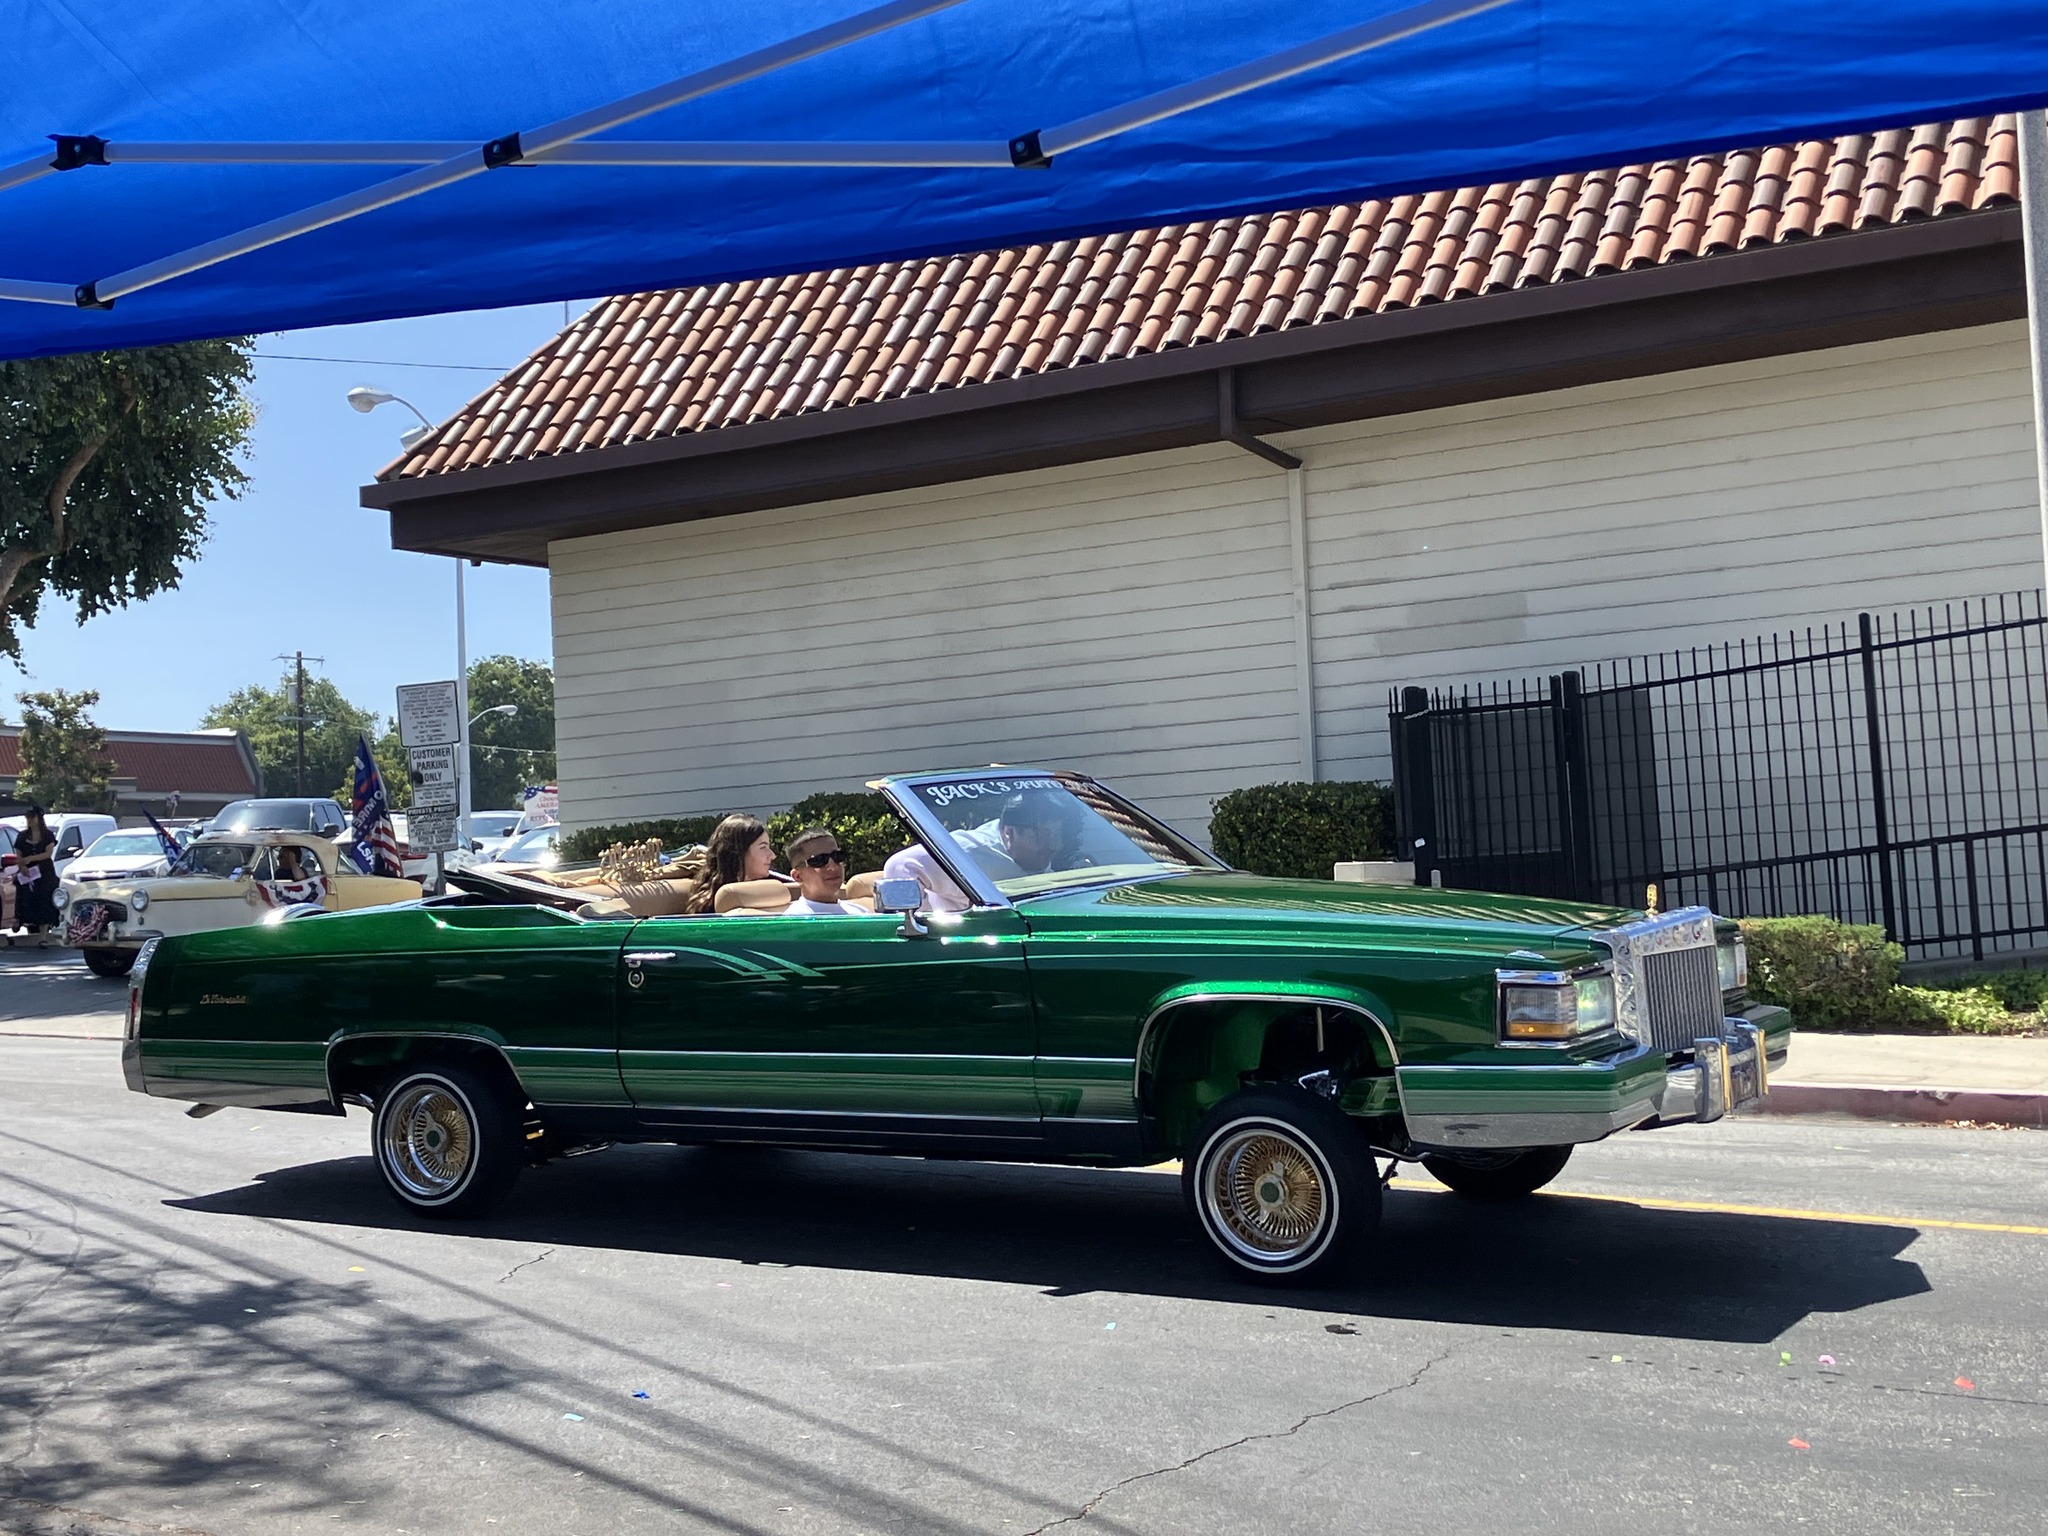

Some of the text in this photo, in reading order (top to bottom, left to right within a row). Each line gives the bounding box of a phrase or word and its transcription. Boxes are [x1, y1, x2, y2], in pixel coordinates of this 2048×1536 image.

[412, 747, 451, 760] CUSTOMER
[416, 760, 449, 770] PARKING
[425, 772, 442, 782] ONLY
[926, 781, 1011, 806] JACK'S
